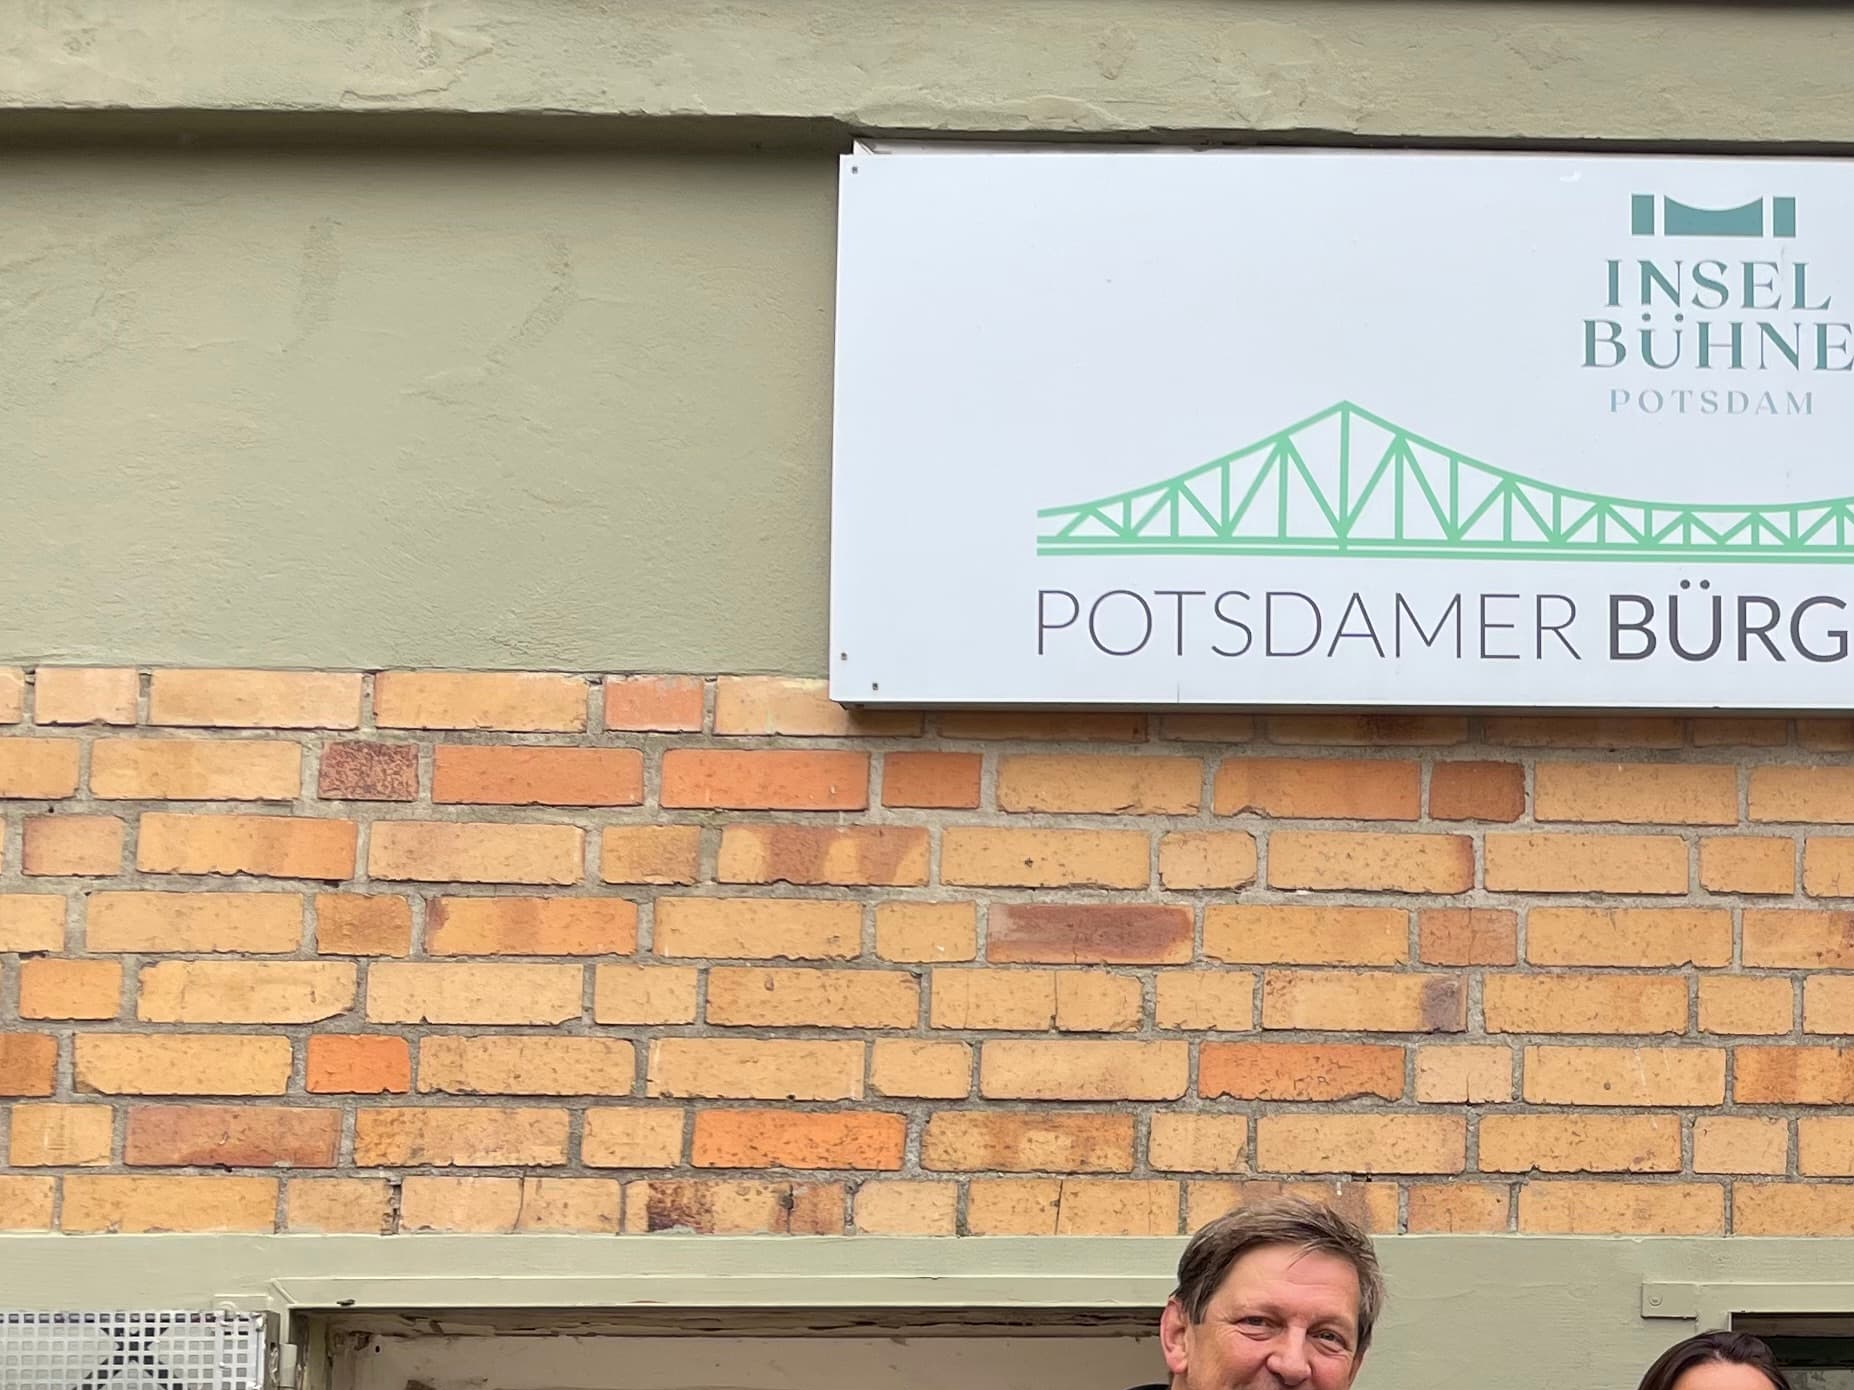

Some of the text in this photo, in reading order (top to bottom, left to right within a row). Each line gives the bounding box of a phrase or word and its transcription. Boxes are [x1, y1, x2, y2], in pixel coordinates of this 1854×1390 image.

[1604, 258, 1832, 311] INSEL
[1609, 387, 1815, 416] POTSDAM
[1036, 588, 1583, 662] POTSDAMER
